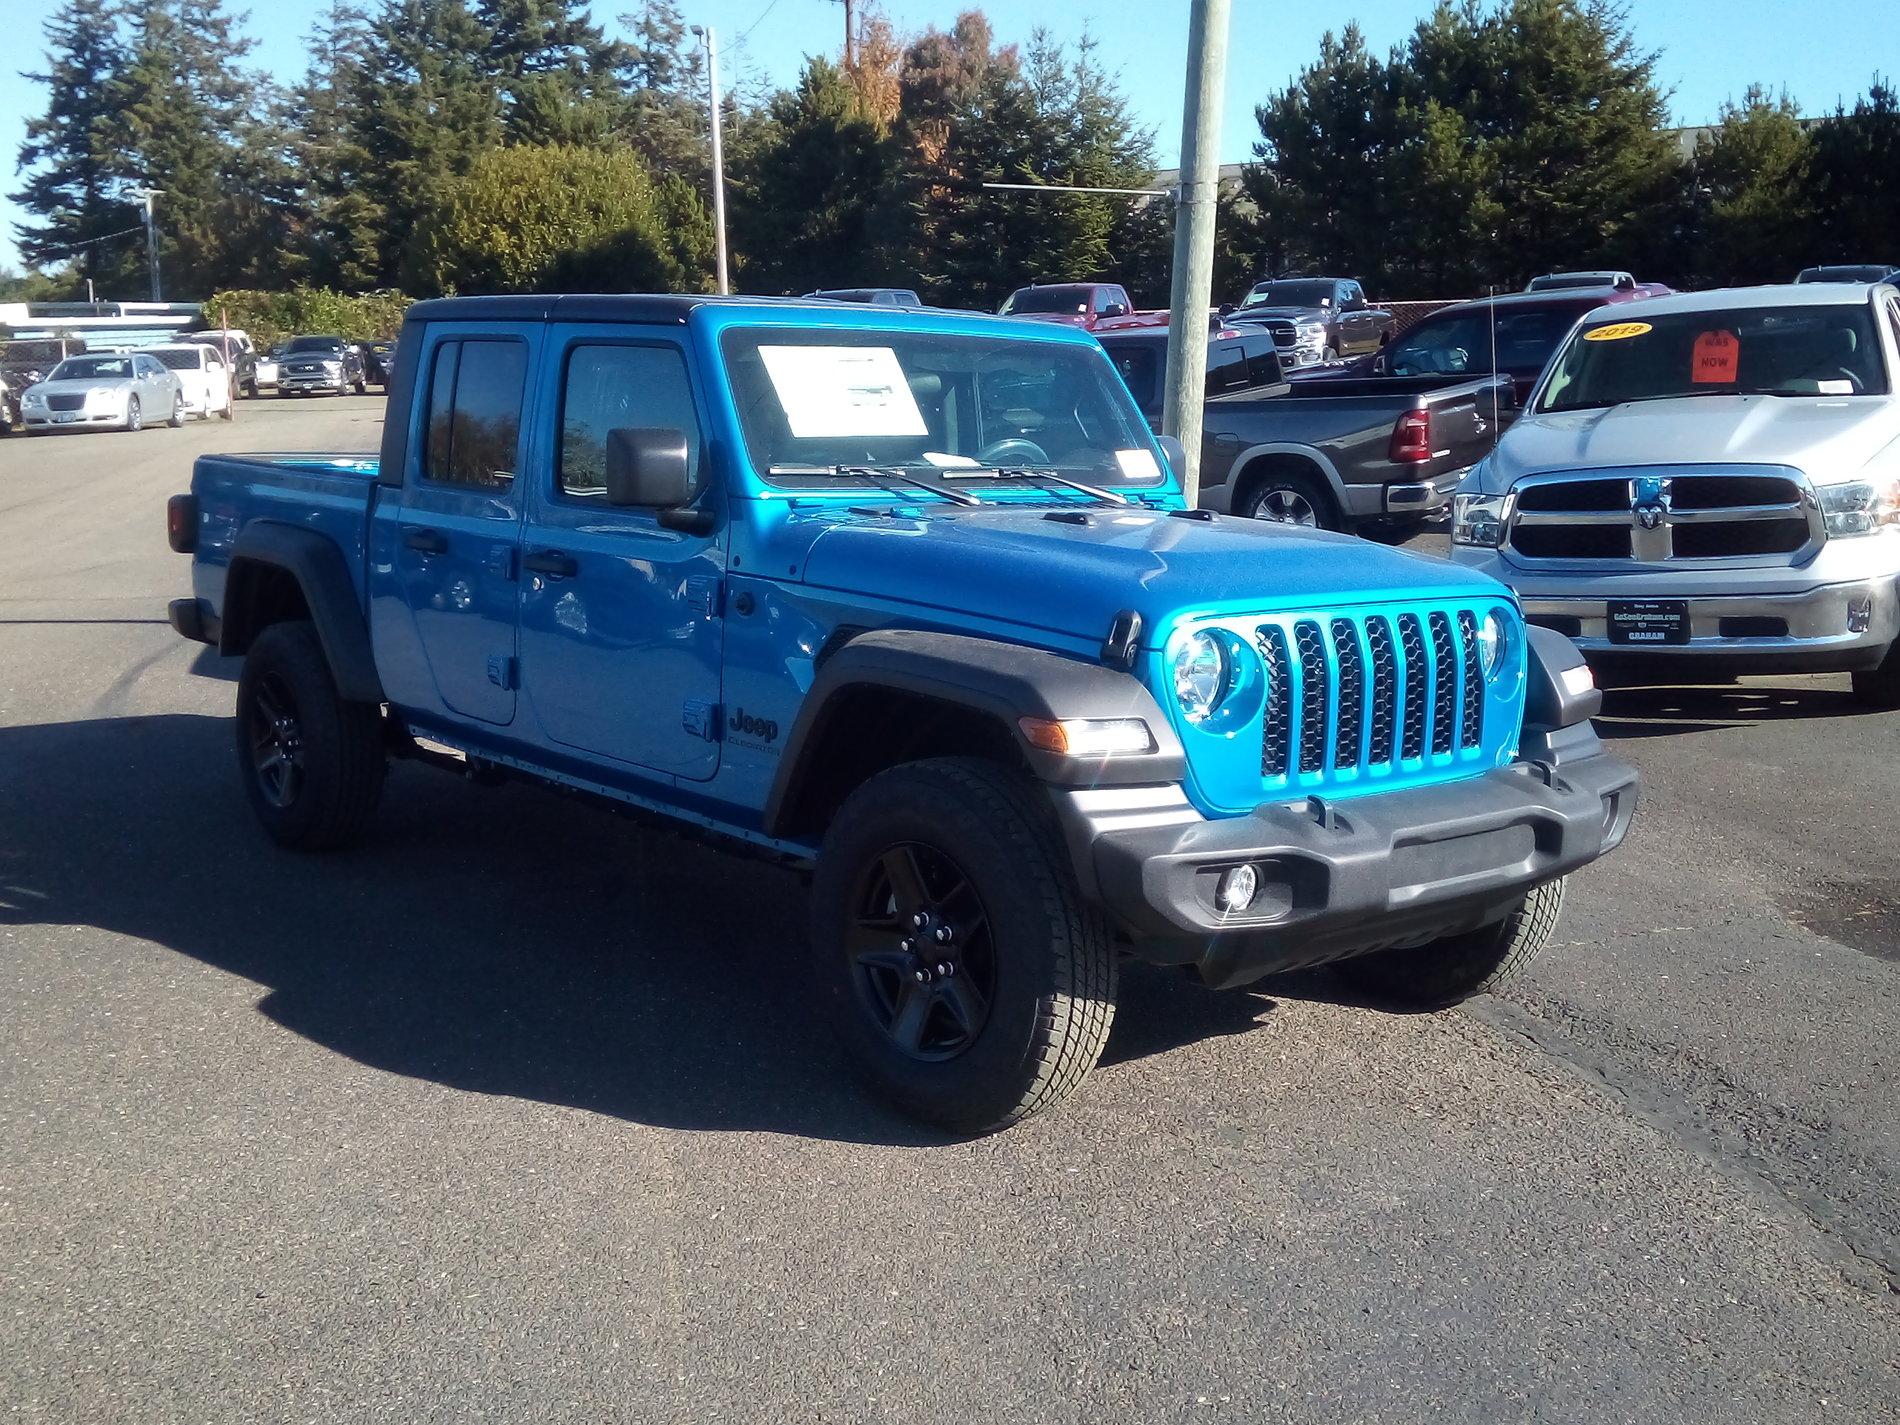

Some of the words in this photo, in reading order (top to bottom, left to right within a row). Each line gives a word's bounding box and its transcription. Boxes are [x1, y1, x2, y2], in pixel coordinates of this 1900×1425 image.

[1590, 325, 1644, 339] 2019
[1701, 357, 1728, 368] NOW
[729, 707, 778, 744] Jeep
